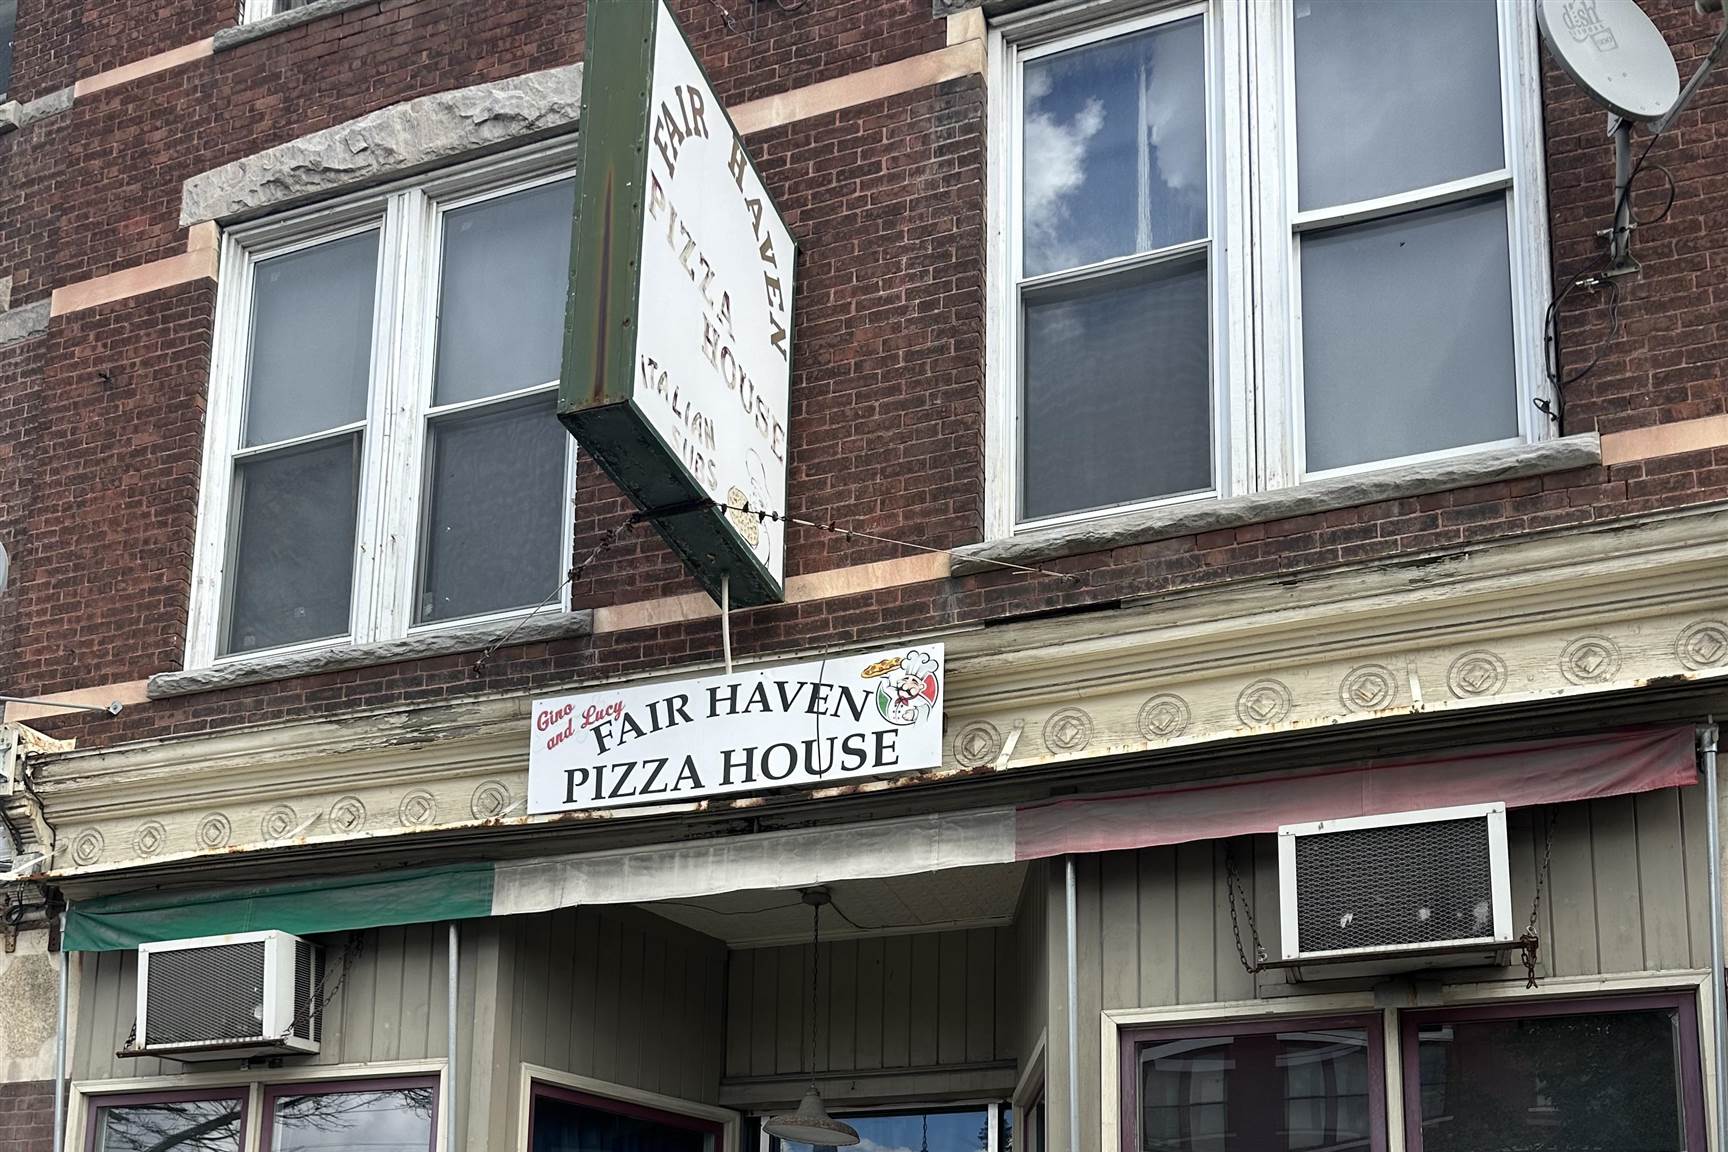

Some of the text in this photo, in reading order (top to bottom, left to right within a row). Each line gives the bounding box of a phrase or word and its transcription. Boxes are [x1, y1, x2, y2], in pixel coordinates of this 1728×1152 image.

[650, 169, 735, 343] PIZZA
[653, 84, 787, 362] FAIR HAVEN
[641, 354, 716, 451] ITALIAN
[701, 312, 784, 463] HOUSE
[672, 425, 718, 491] SUBS
[536, 701, 575, 732] Gino
[546, 697, 625, 751] and Lucy
[590, 680, 875, 756] FAIR HAVEN
[562, 728, 900, 804] PIZZA HOUSE
